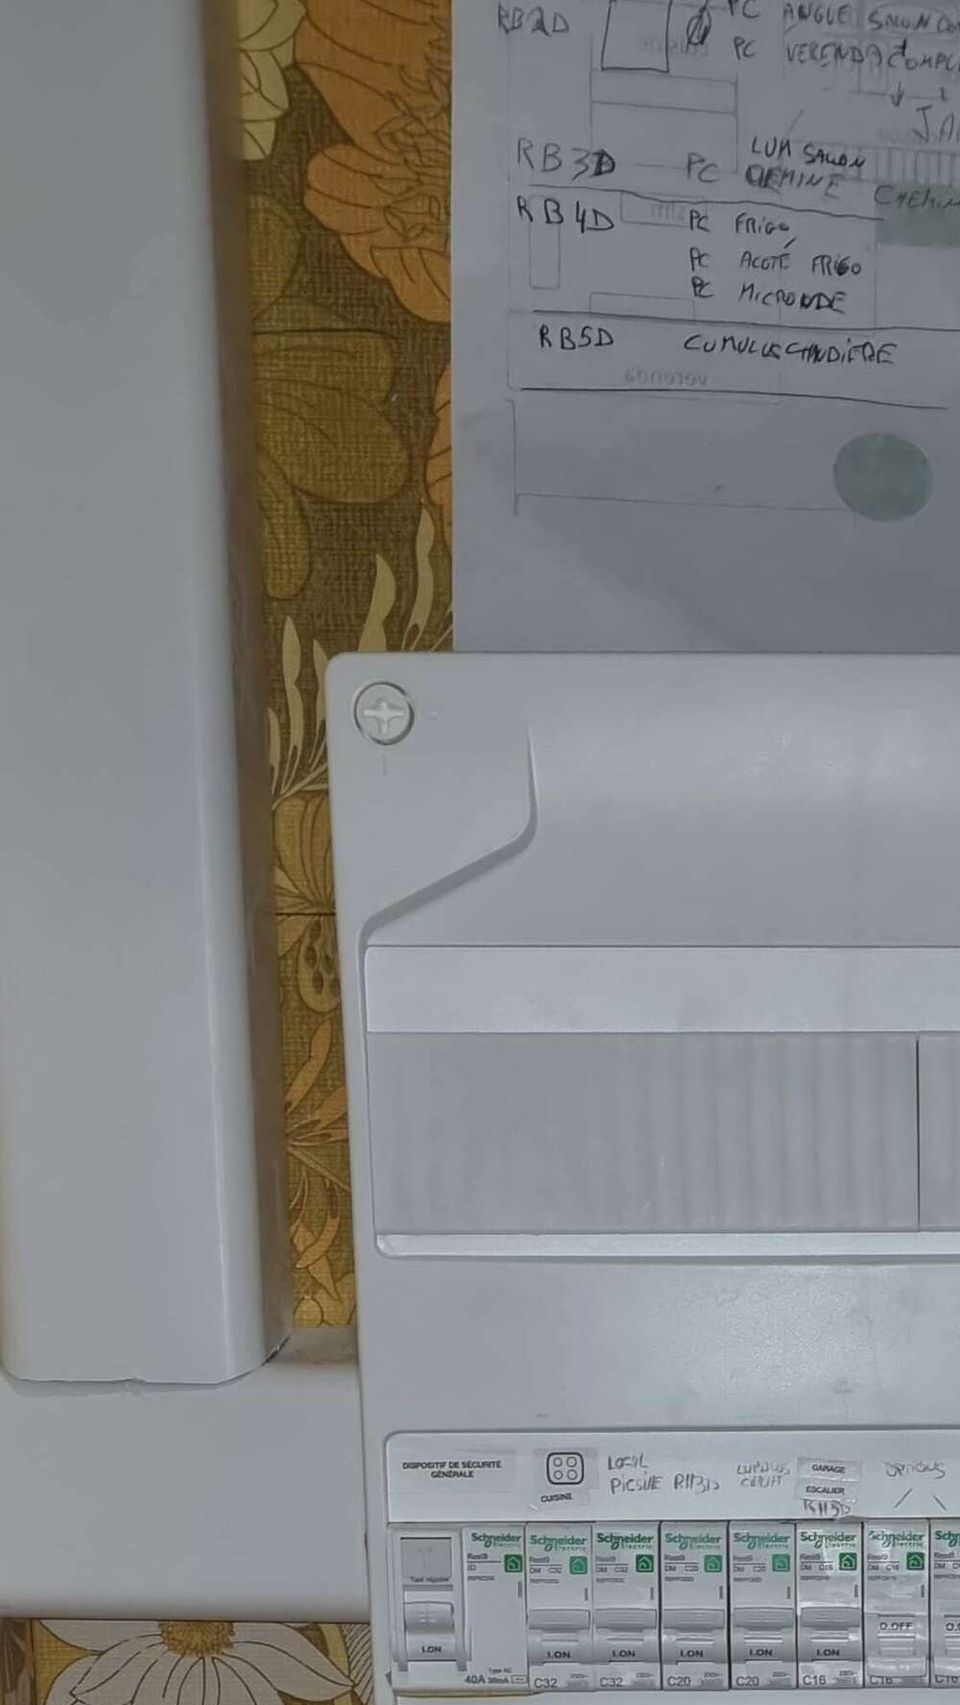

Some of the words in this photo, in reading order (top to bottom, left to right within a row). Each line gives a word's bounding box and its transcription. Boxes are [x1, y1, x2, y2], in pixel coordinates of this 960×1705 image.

[734, 36, 757, 59] PC
[687, 153, 722, 183] PC
[690, 209, 711, 232] PC
[690, 247, 712, 272] PC
[402, 1461, 447, 1470] DISPOSITIF
[449, 1461, 460, 1470] DE
[530, 1535, 587, 1551] Schneider
[597, 1533, 654, 1549] Schneider
[665, 1533, 722, 1550] Schneider
[733, 1532, 790, 1550] Schneider
[465, 1675, 485, 1684] 40A
[534, 1677, 558, 1689] C32
[600, 1677, 623, 1688] C32
[667, 1676, 691, 1687] C20
[736, 1676, 760, 1687] C20
[802, 1675, 827, 1686] C16
